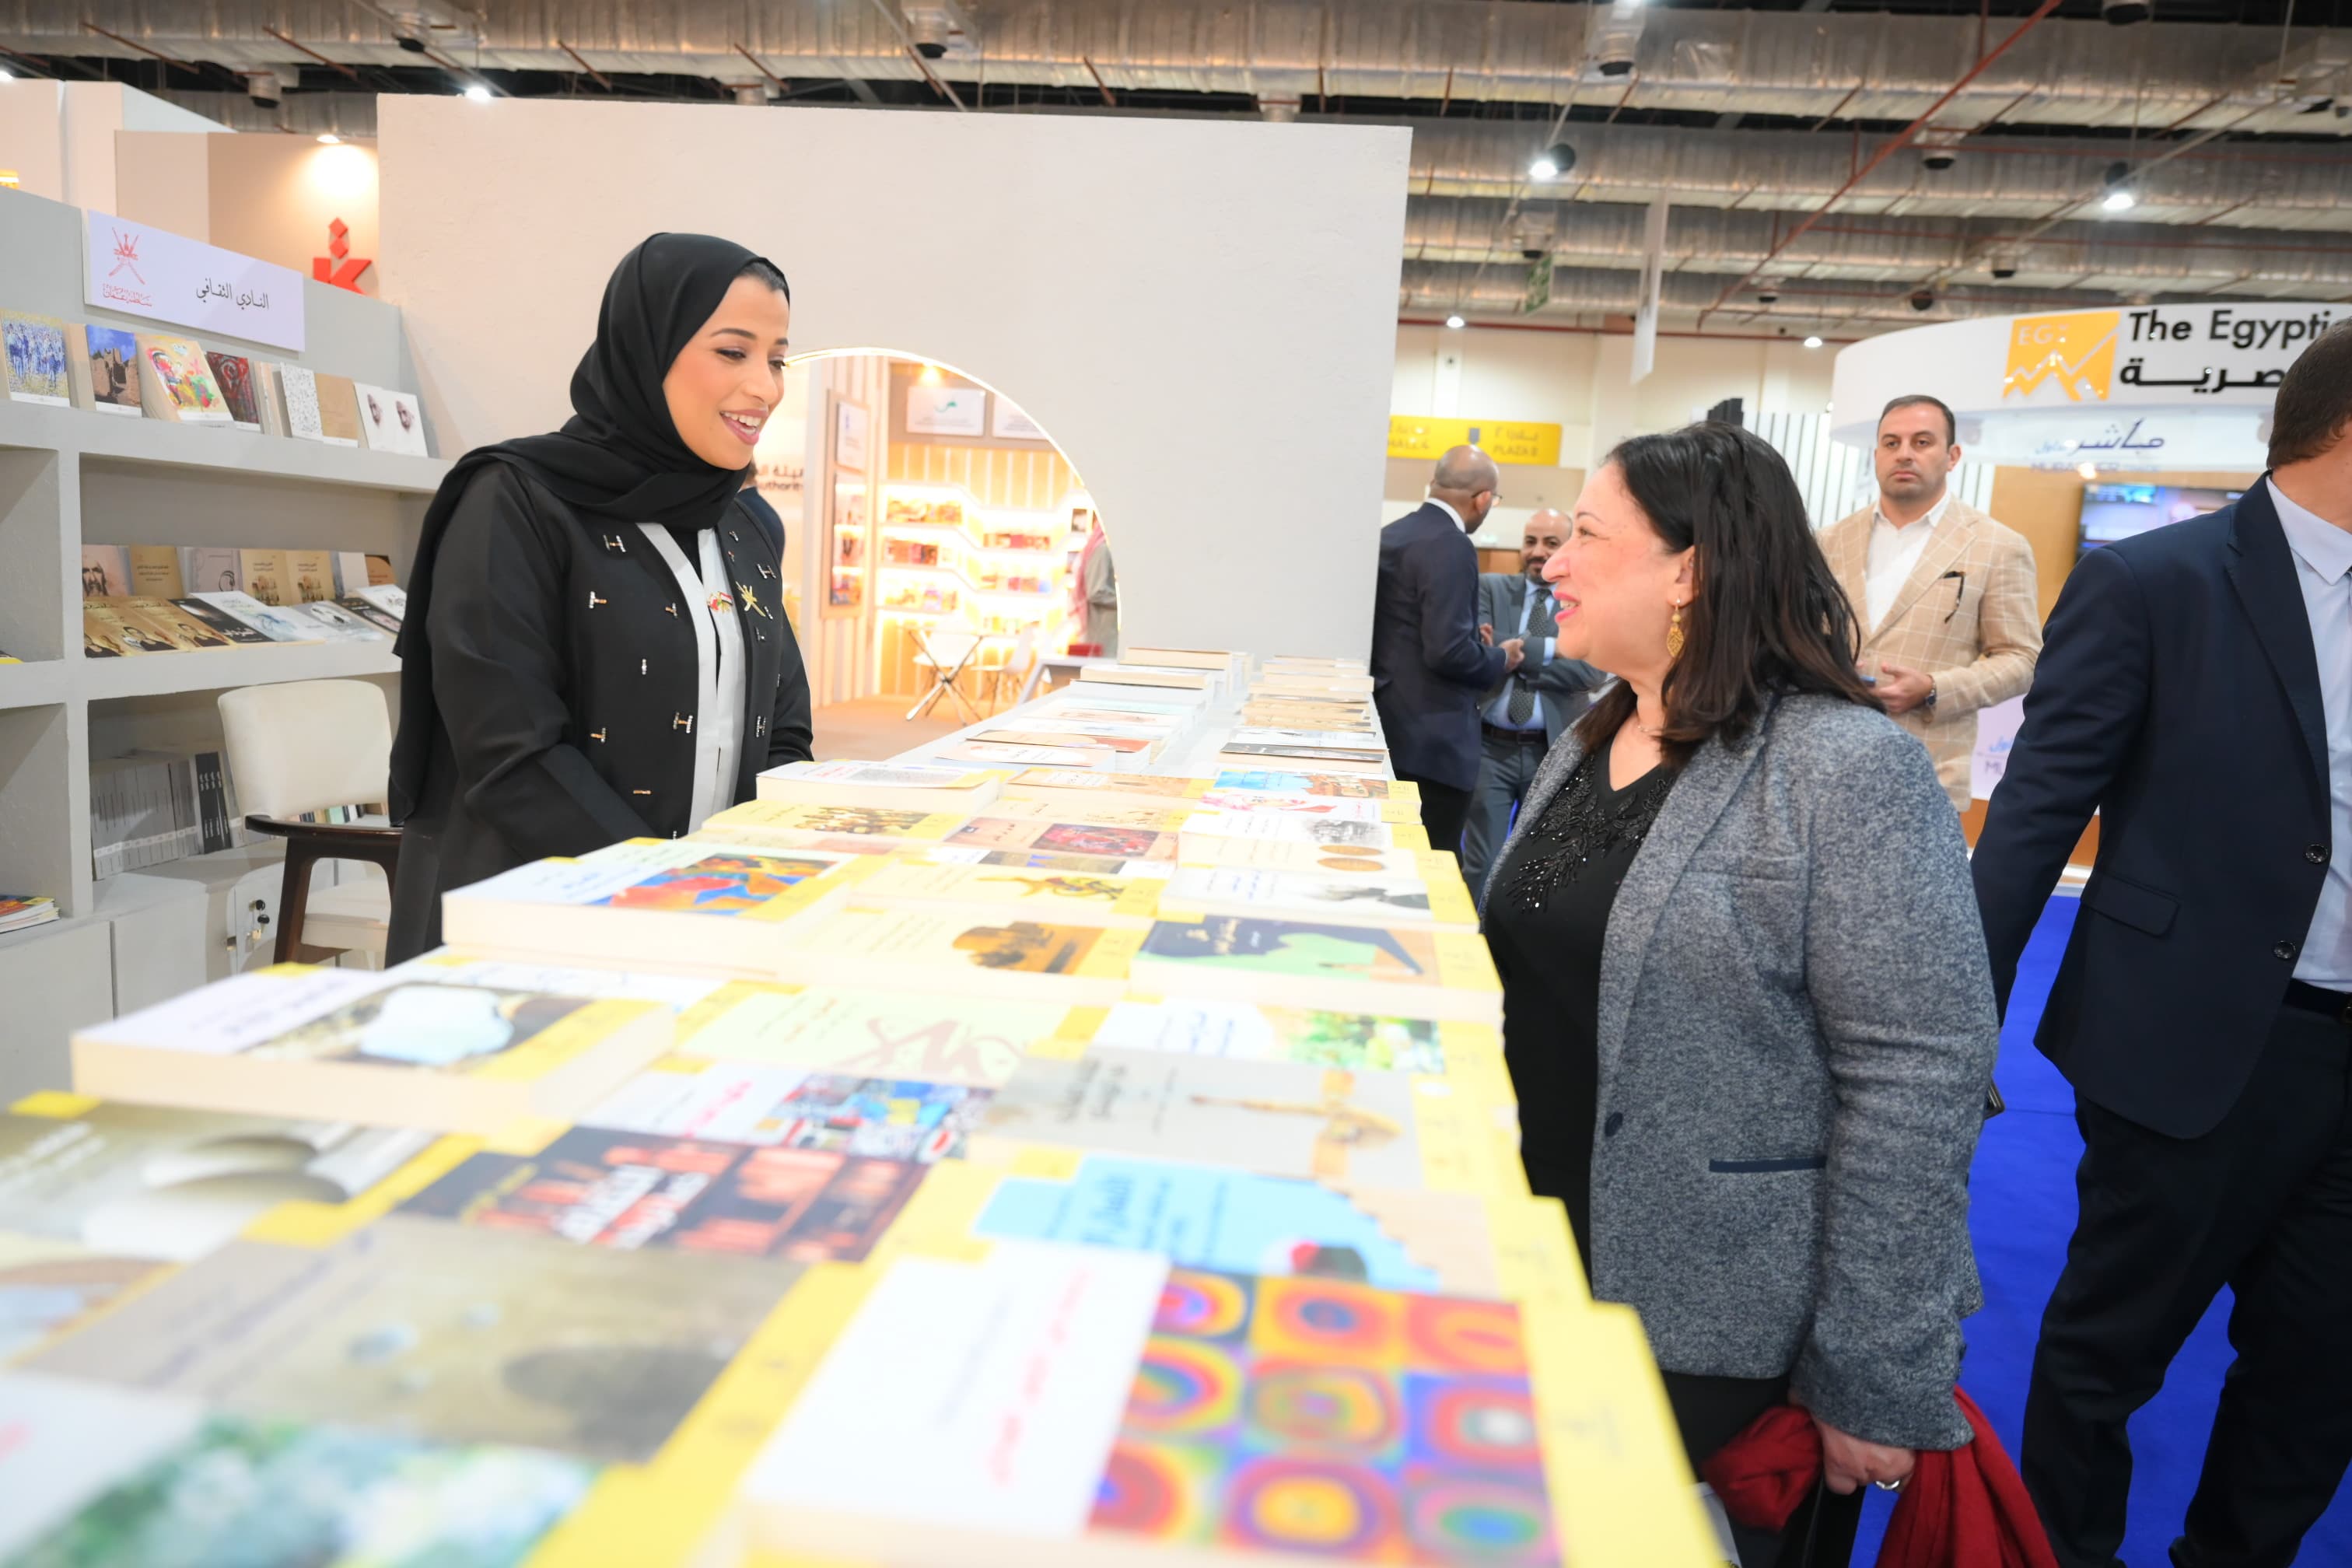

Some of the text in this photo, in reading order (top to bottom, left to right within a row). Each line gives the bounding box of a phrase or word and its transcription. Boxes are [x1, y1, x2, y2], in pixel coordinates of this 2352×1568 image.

[195, 278, 269, 310] النادي الثقافي
[2128, 309, 2331, 350] The Egypti
[2120, 357, 2286, 394] صرية
[2067, 417, 2165, 456] مباشر
